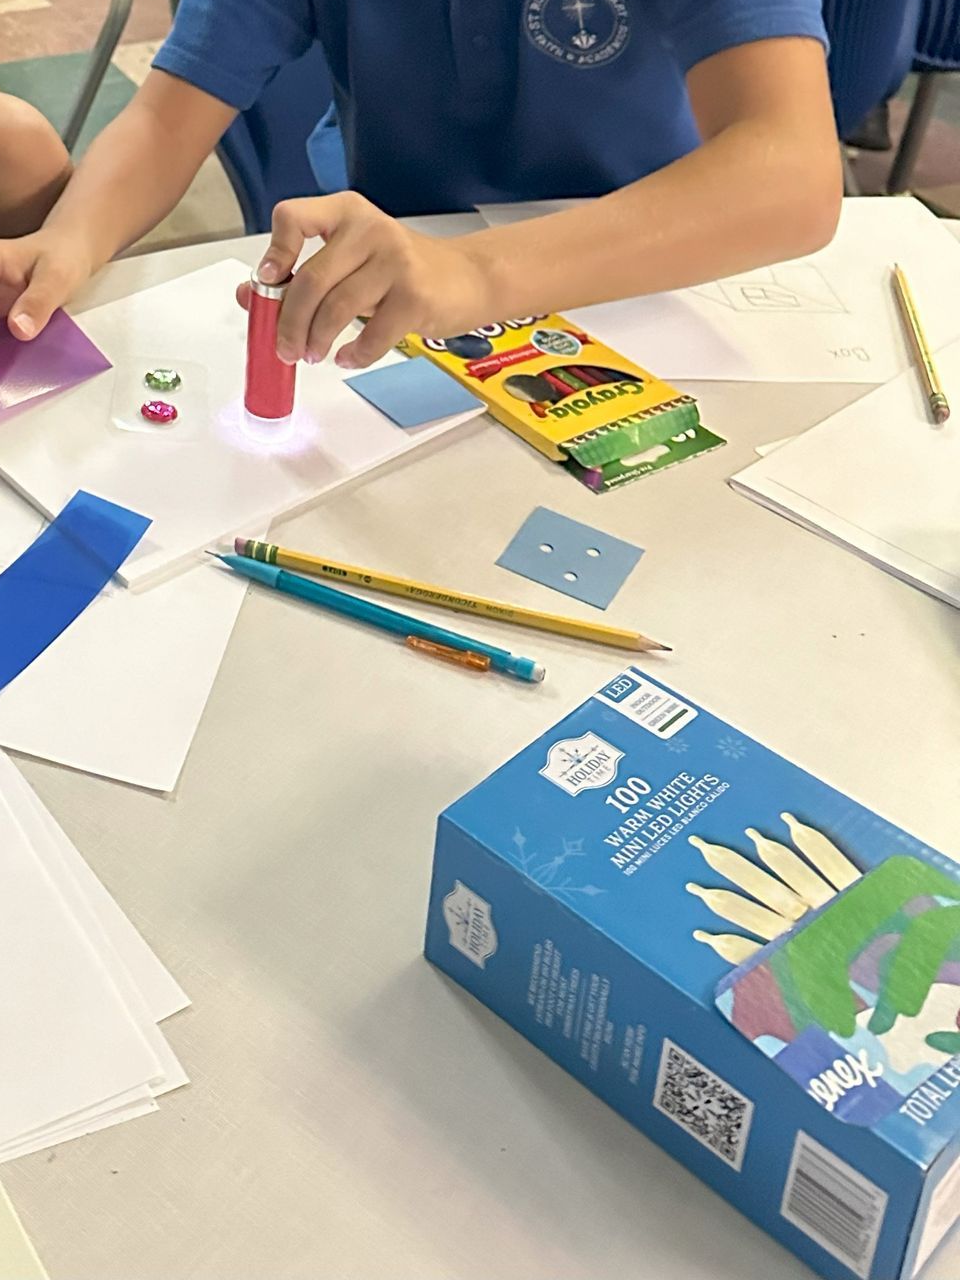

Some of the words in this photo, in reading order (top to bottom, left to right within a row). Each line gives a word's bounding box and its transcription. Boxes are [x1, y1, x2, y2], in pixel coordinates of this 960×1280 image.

[548, 381, 644, 419] Crayola
[408, 585, 478, 609] TICONDEROGA
[604, 677, 634, 699] LED
[566, 750, 611, 786] HOLIDAY
[586, 765, 612, 783] TIME
[603, 809, 653, 848] WARM
[645, 771, 695, 811] WHITE
[605, 776, 652, 814] 100
[610, 837, 648, 869] MINI
[640, 814, 673, 841] LED
[667, 774, 720, 817] LIGHTS
[623, 864, 638, 877] 100
[634, 851, 652, 869] MINI
[650, 834, 672, 854] LUCES
[669, 823, 684, 837] LED
[680, 801, 708, 825] BLANCO
[468, 906, 485, 956] HOLIDAY
[807, 1048, 884, 1112] enex
[899, 1080, 953, 1126] TOTAL
